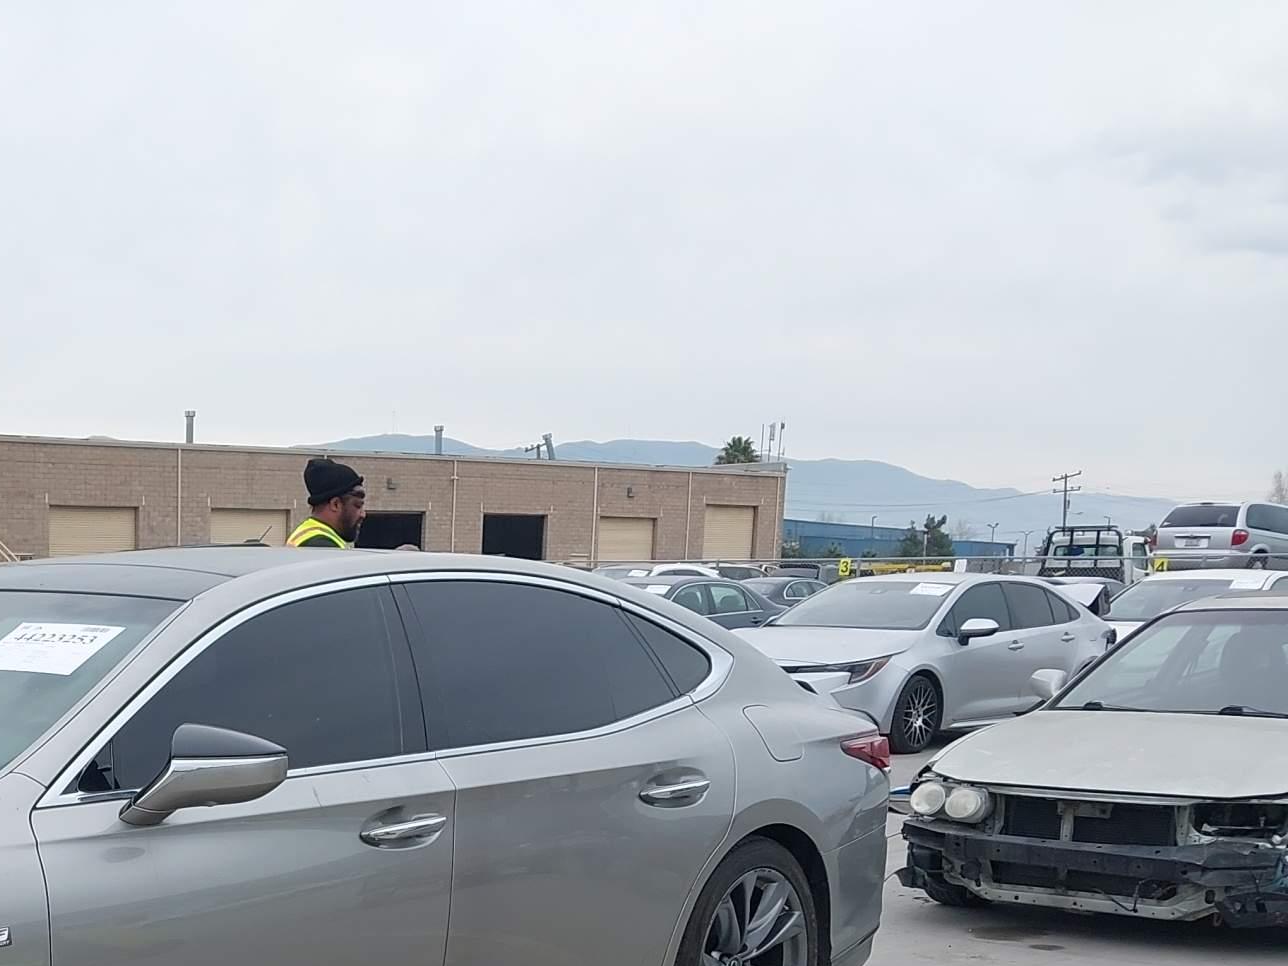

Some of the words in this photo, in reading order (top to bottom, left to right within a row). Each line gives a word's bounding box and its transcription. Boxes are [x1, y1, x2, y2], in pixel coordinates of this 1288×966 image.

[841, 560, 849, 573] 3
[1156, 560, 1165, 572] 4
[14, 632, 99, 645] 44223253
